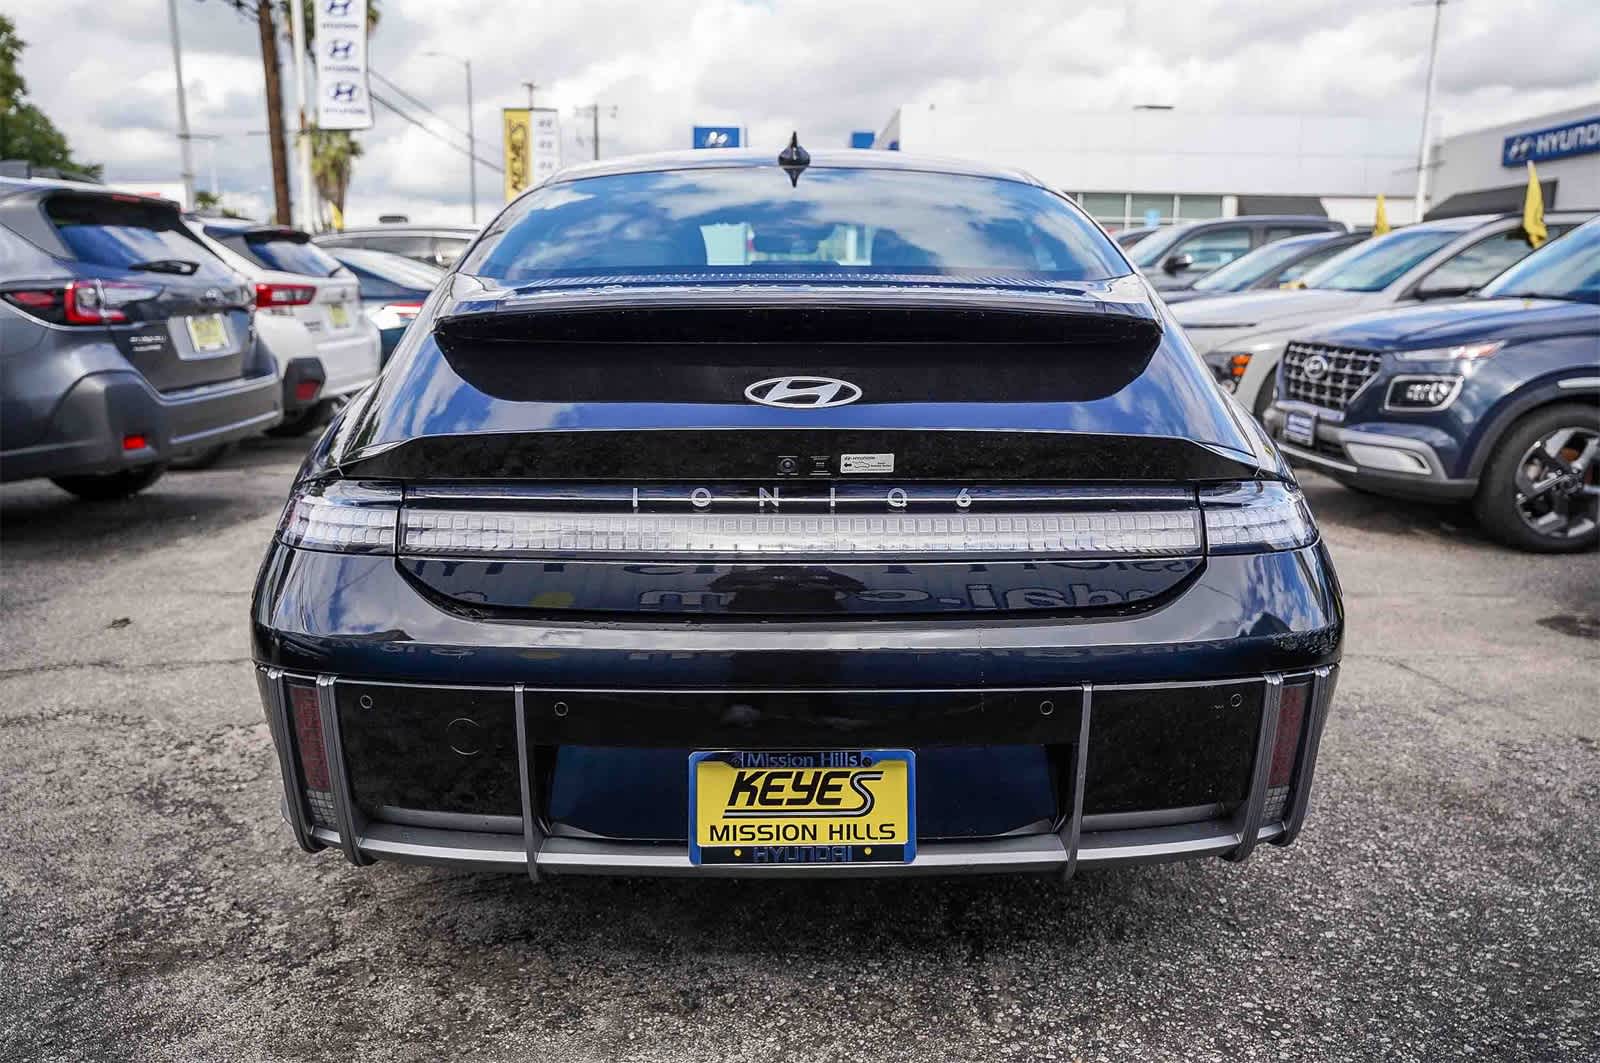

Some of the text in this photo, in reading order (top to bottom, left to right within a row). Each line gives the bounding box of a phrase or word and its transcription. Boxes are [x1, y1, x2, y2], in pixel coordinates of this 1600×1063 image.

[746, 751, 859, 768] Mission Hills
[724, 770, 884, 816] KEYES
[709, 823, 896, 842] MISSION HILLS
[752, 846, 853, 863] HYUNDAI
